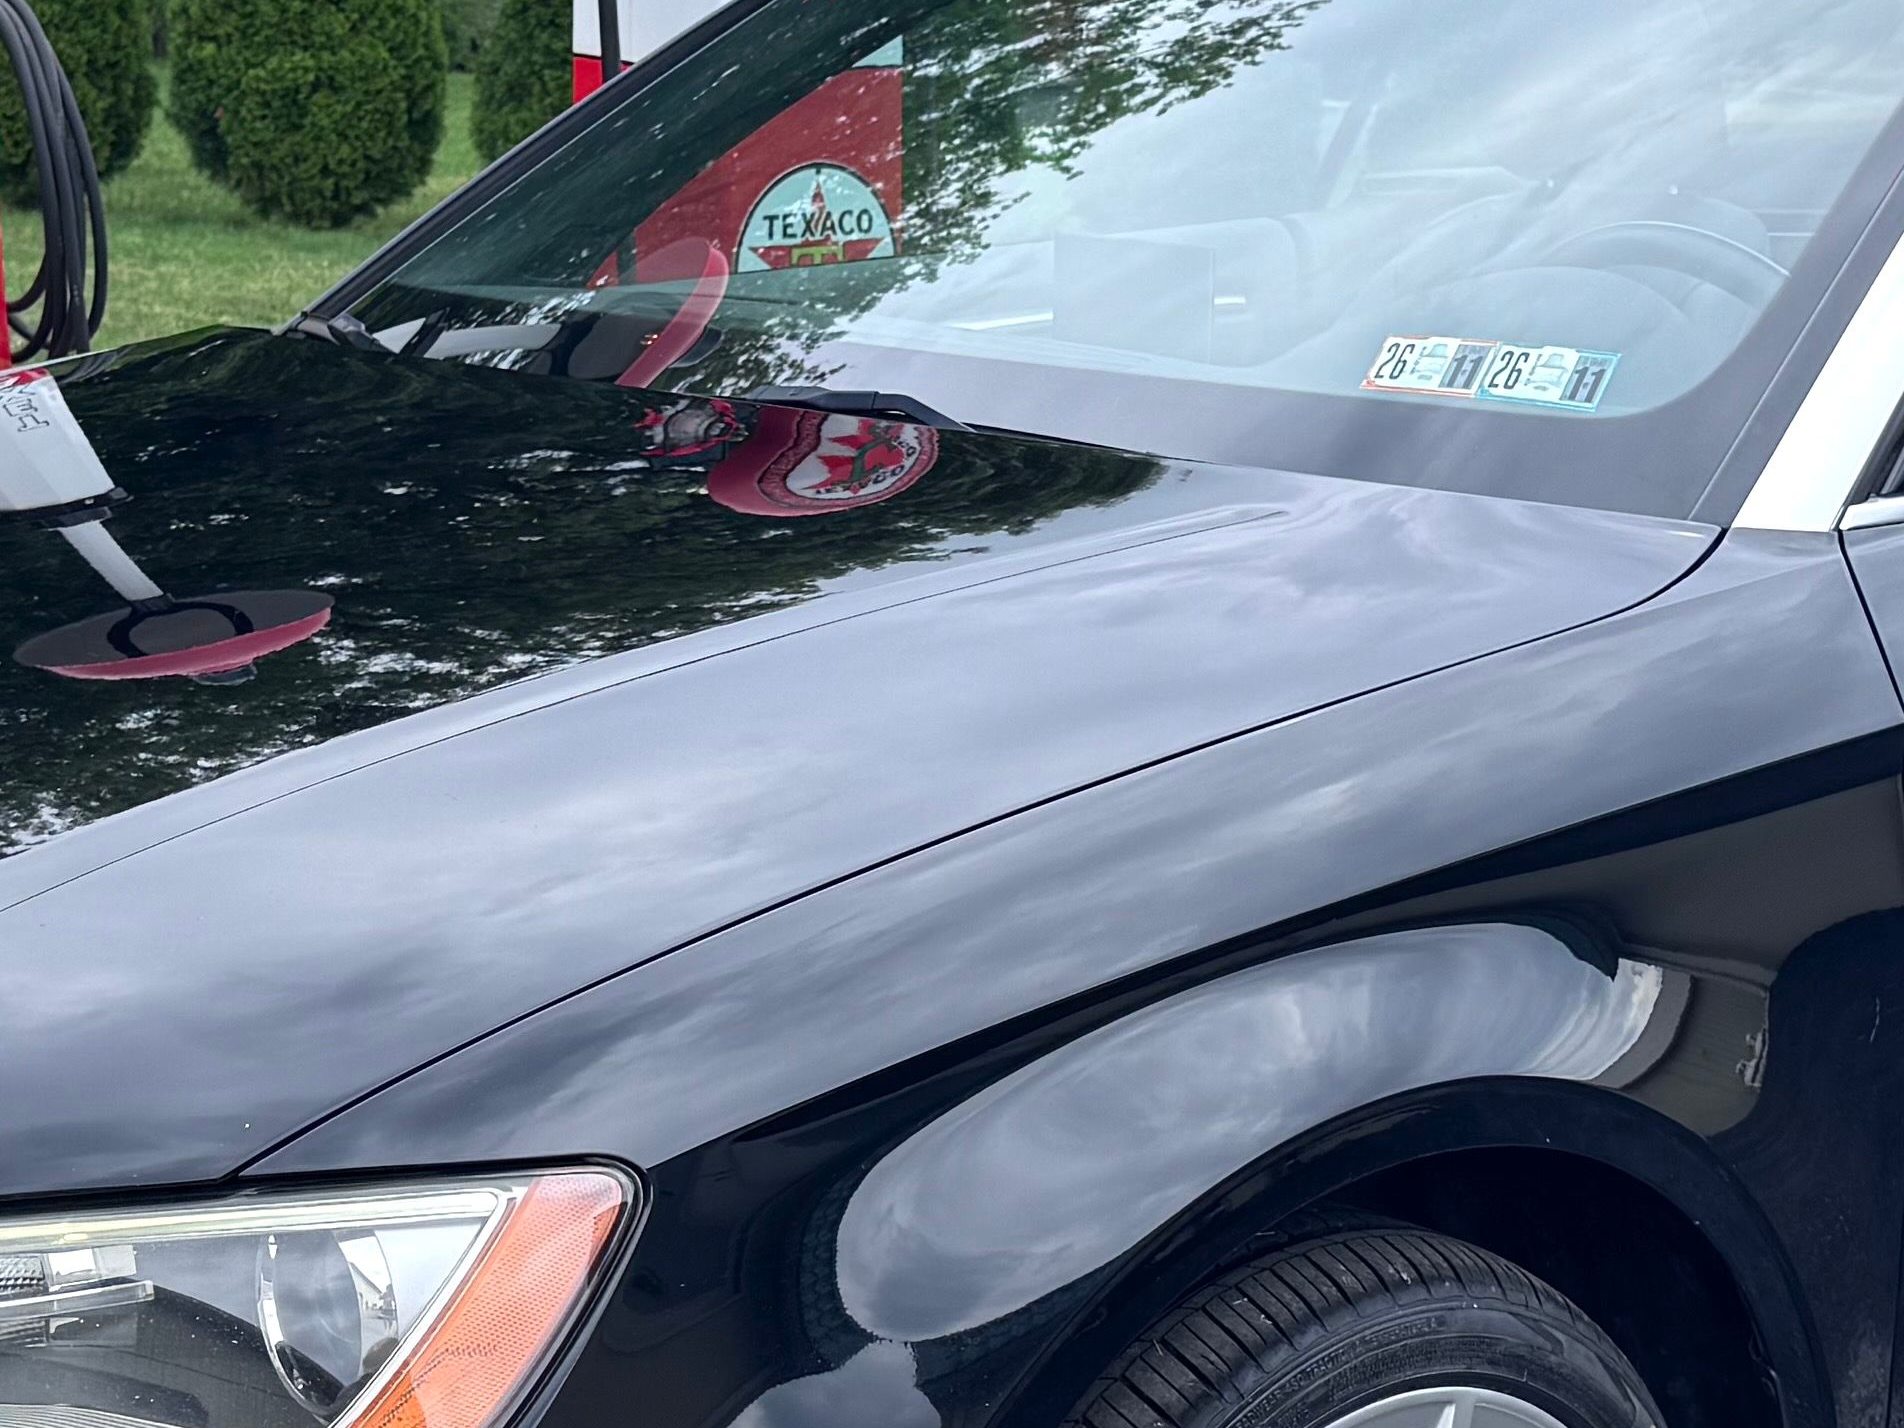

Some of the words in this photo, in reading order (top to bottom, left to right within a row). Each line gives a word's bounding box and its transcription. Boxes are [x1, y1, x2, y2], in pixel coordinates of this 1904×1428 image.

[763, 209, 873, 240] TEXACO
[1374, 342, 1416, 380] 26
[1446, 354, 1484, 389] 11
[1488, 350, 1529, 390] 26
[1568, 366, 1607, 402] 11
